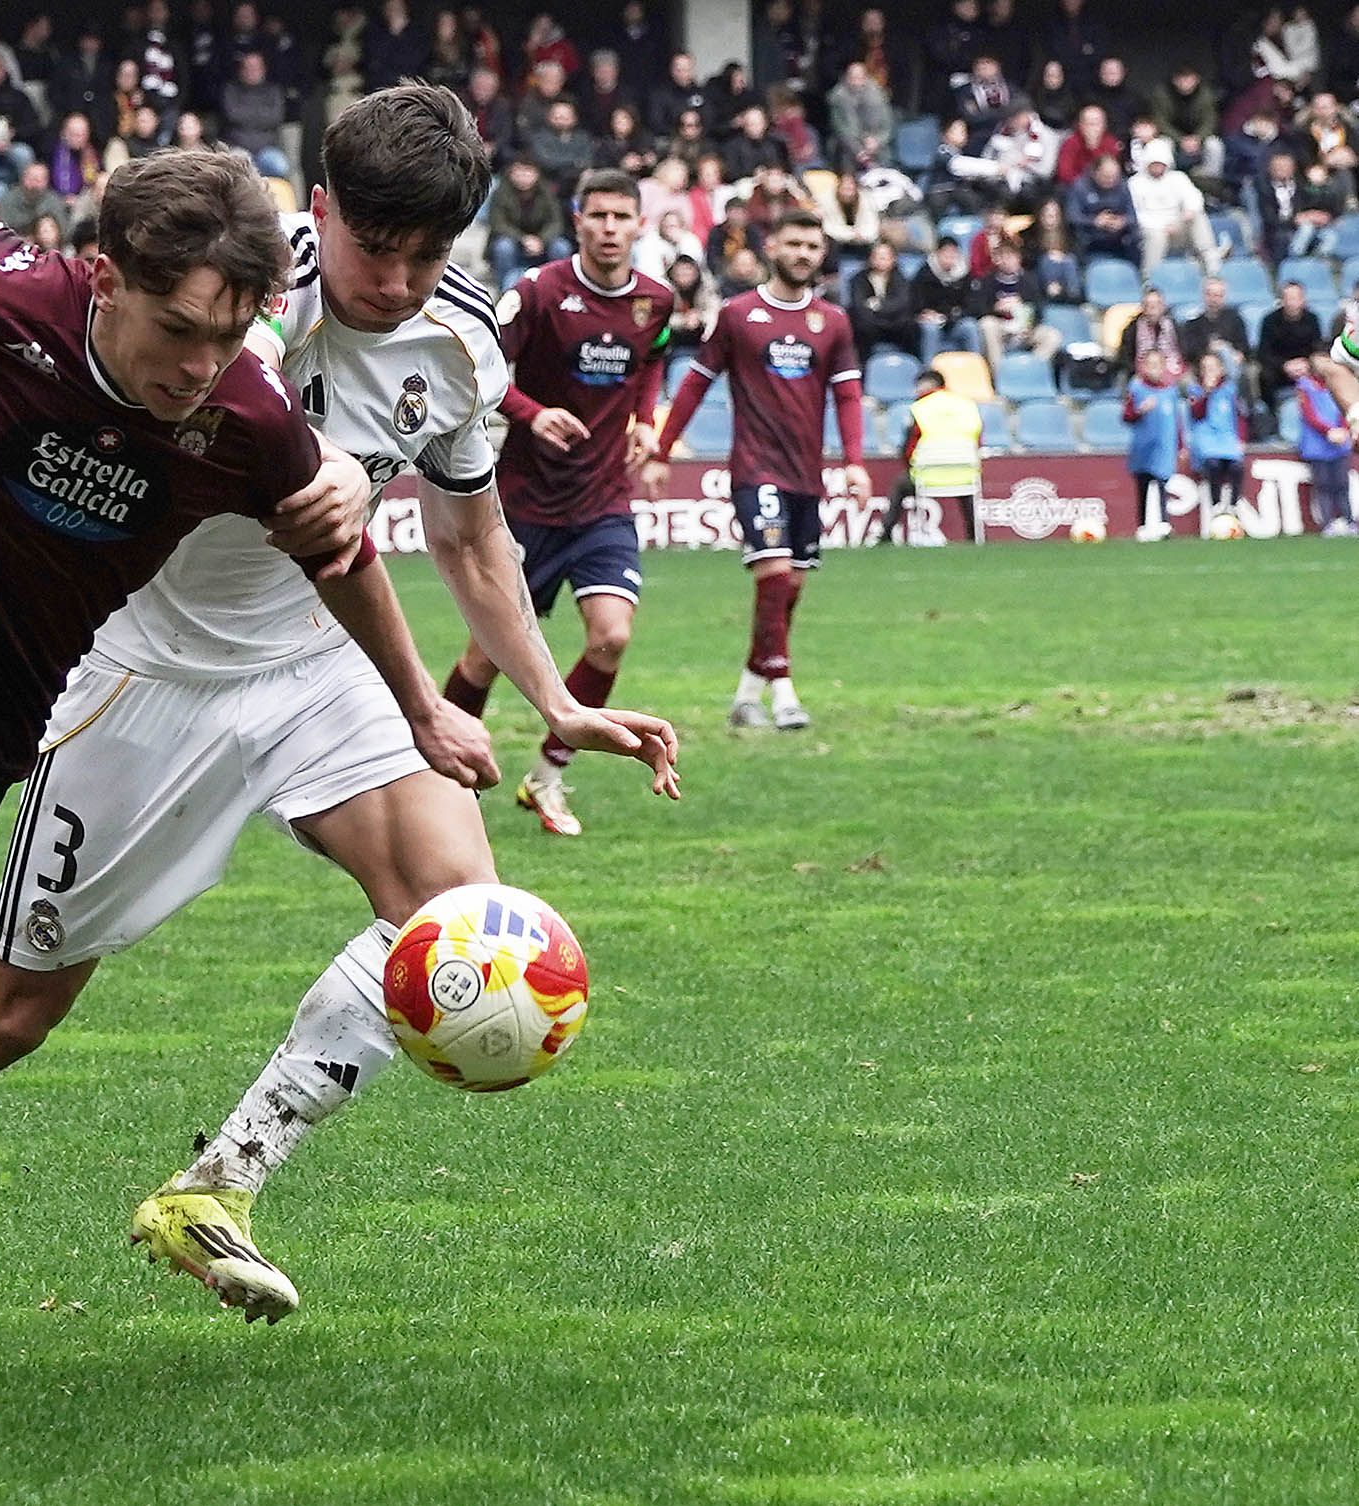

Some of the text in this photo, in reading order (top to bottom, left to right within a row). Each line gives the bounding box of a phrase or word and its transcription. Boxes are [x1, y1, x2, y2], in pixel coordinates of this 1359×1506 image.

[27, 459, 129, 523] Galicia
[32, 432, 149, 499] Estrella
[757, 484, 781, 519] 5
[36, 802, 85, 894] 3
